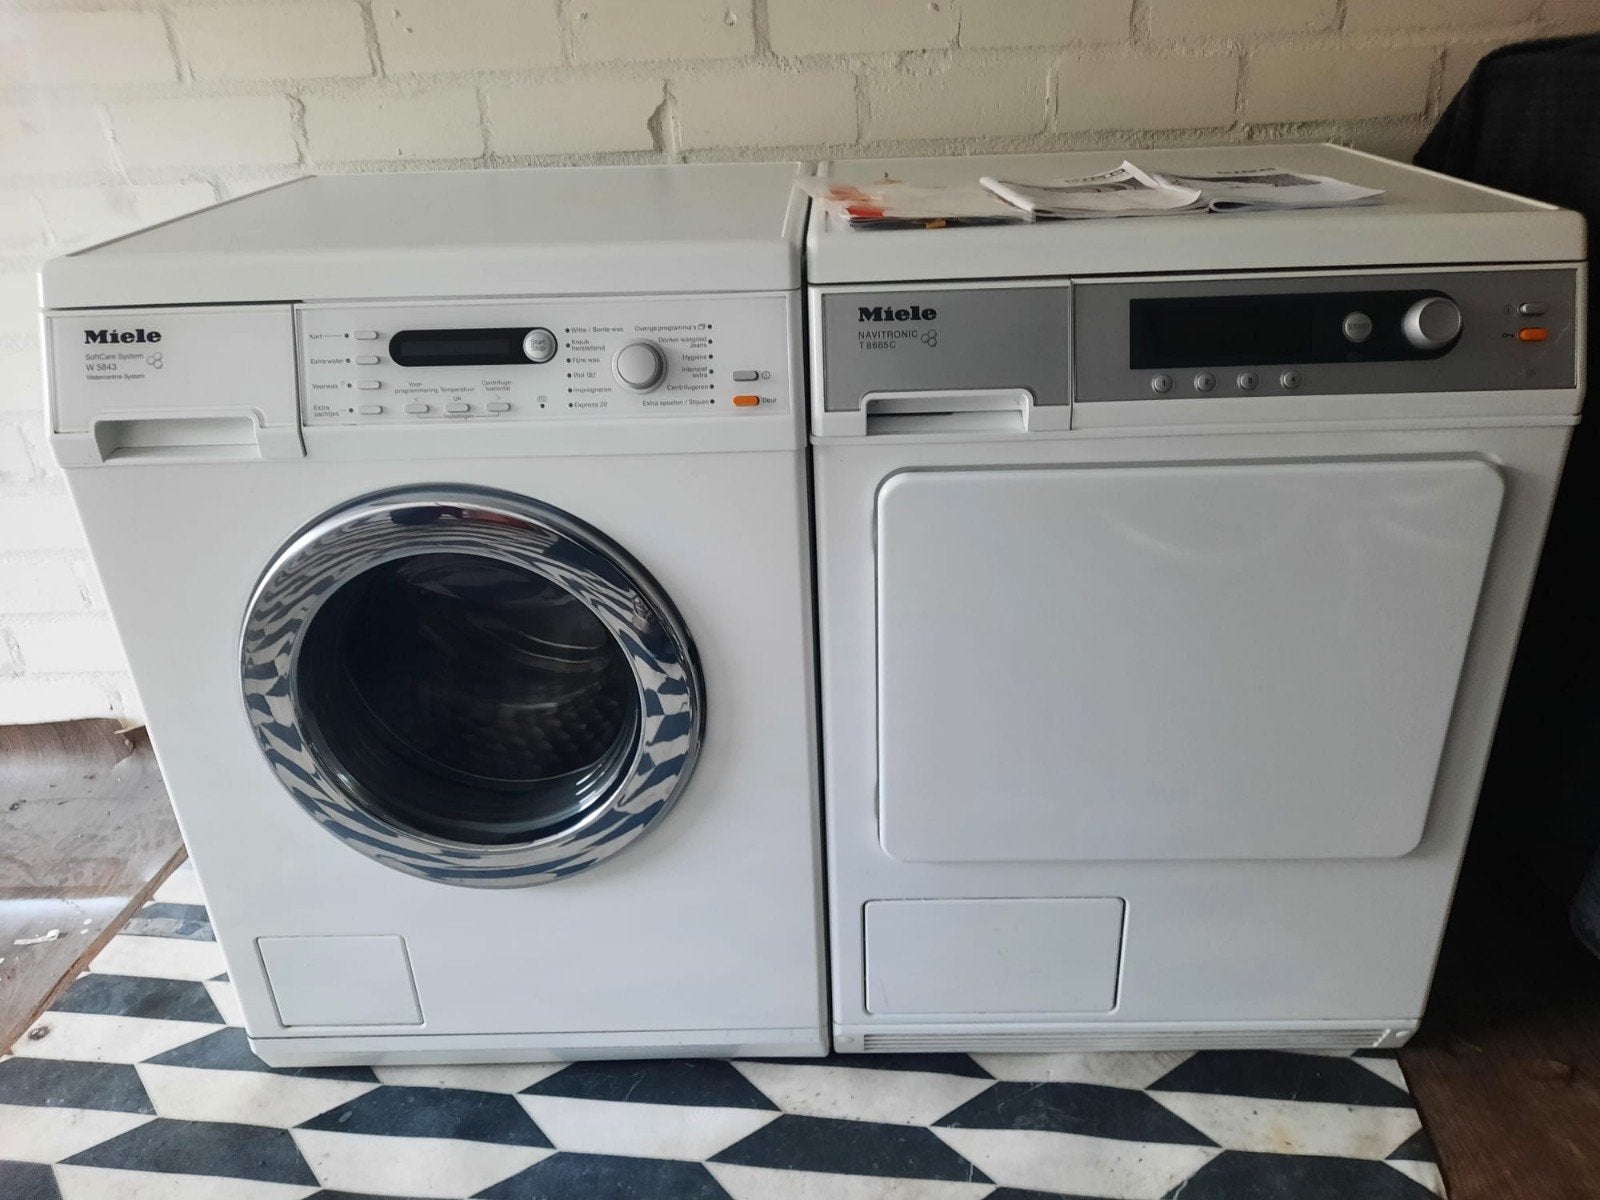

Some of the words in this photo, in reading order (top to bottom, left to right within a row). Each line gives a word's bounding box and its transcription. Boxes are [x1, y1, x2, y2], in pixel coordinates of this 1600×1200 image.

[858, 306, 937, 321] Miele
[84, 329, 162, 344] Miele
[858, 330, 918, 339] NAVITRONIC
[85, 353, 117, 361] SoftCare
[118, 352, 144, 360] System
[86, 363, 95, 371] W
[96, 363, 117, 371] 5843
